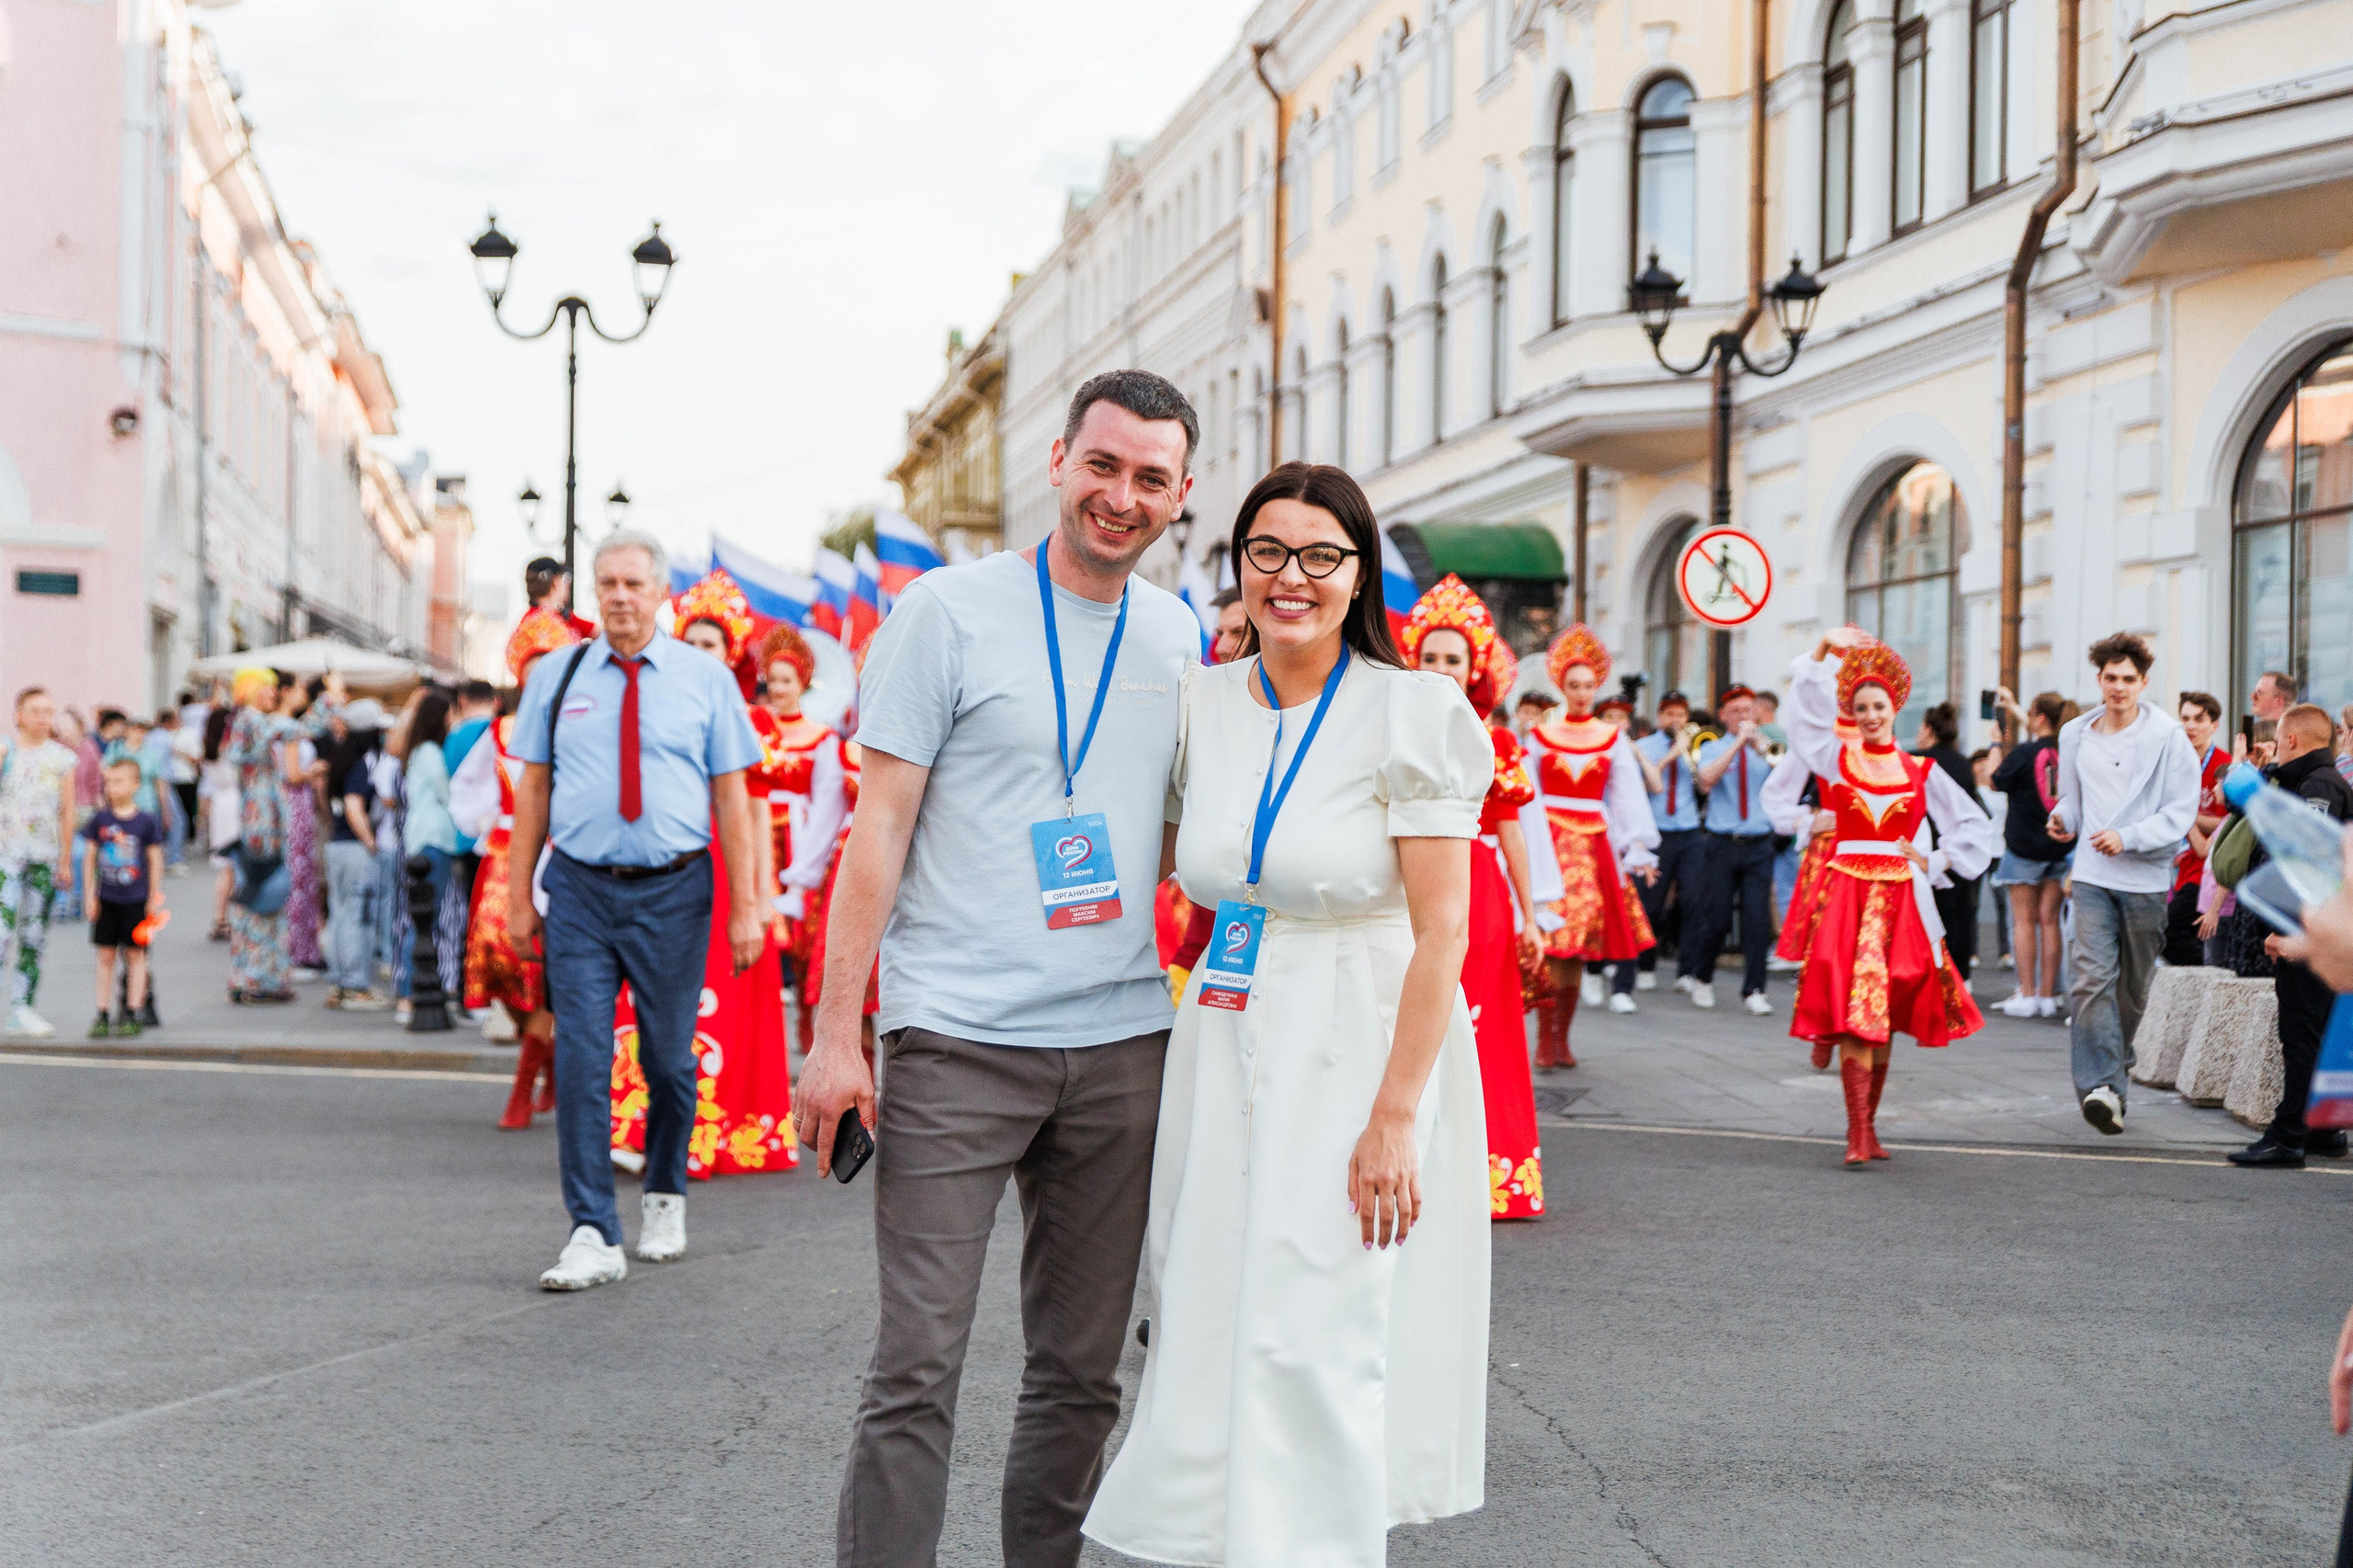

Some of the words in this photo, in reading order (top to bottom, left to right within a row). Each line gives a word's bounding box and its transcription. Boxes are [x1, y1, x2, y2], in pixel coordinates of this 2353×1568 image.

[1071, 869, 1094, 878] ИЮНЯ
[1052, 885, 1110, 901] ОРГАНИЗАТОР
[1073, 909, 1097, 917] МАКСИМ
[1071, 915, 1100, 923] СЕРГЕЕВИЧ
[1209, 973, 1247, 984] ОРГАНИЗАТОР
